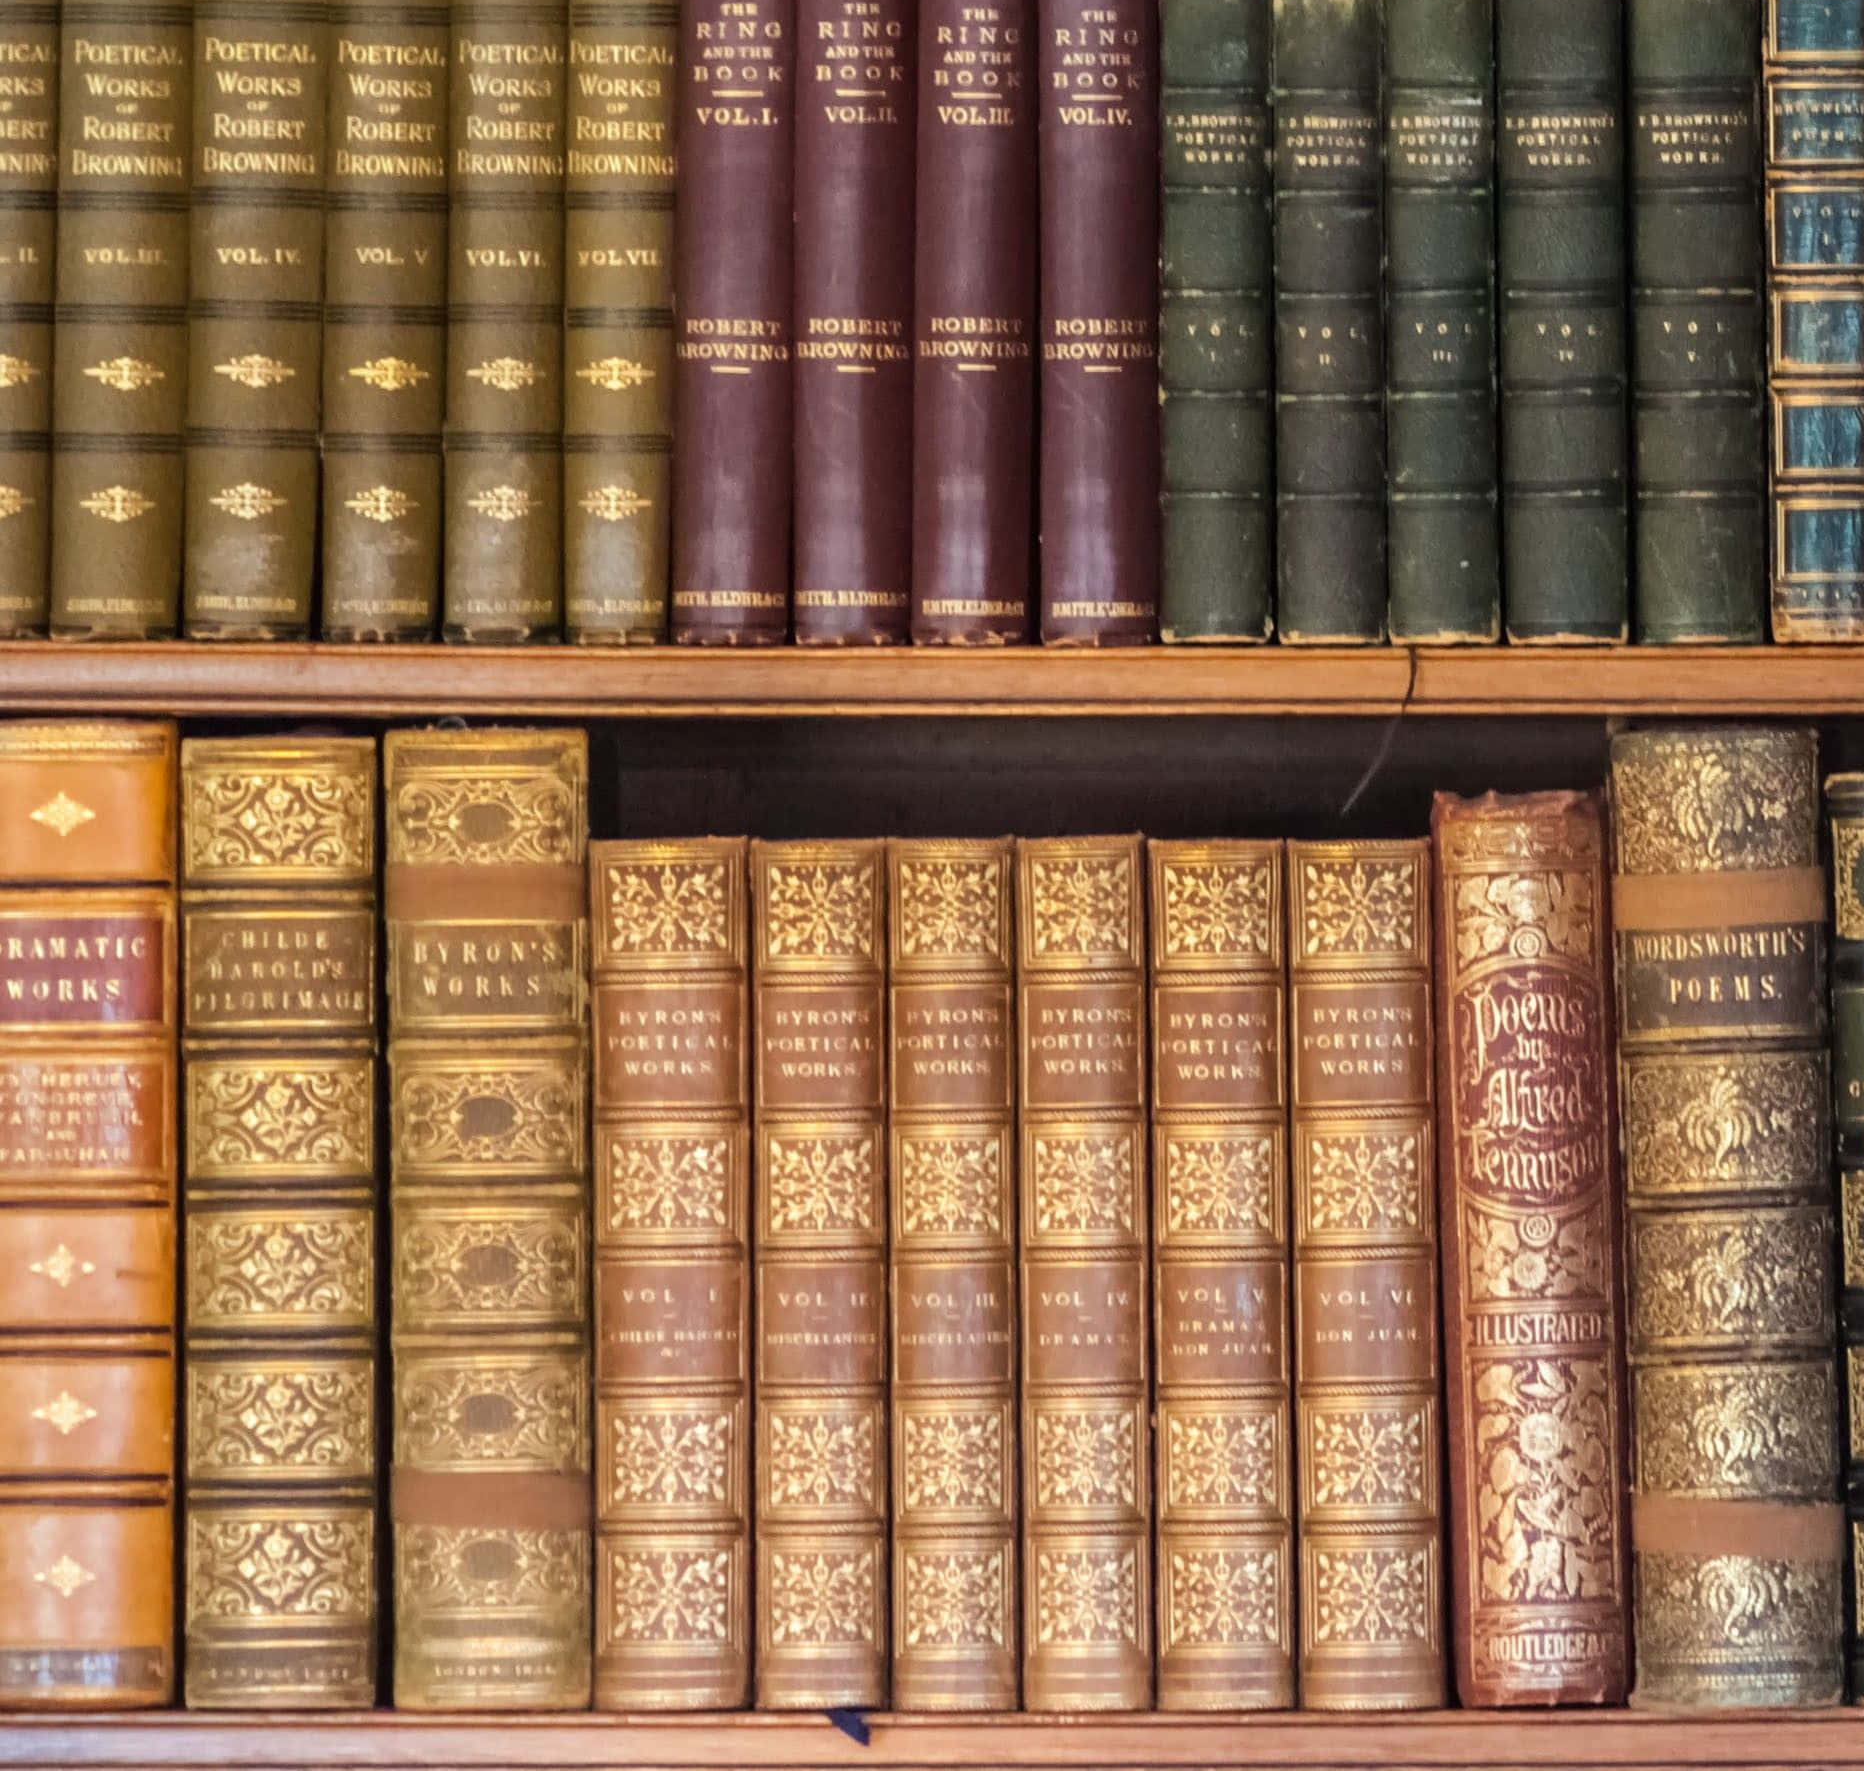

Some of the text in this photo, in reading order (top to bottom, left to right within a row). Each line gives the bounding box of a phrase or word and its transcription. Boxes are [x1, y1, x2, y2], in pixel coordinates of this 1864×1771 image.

[697, 22, 781, 40] RING
[205, 38, 315, 63] POETICAL
[217, 72, 301, 97] WORKS
[694, 66, 782, 82] BOOK
[249, 102, 269, 111] OF
[213, 116, 305, 141] ROBERT
[203, 148, 315, 173] BROWNING
[414, 941, 558, 965] BYRON'S
